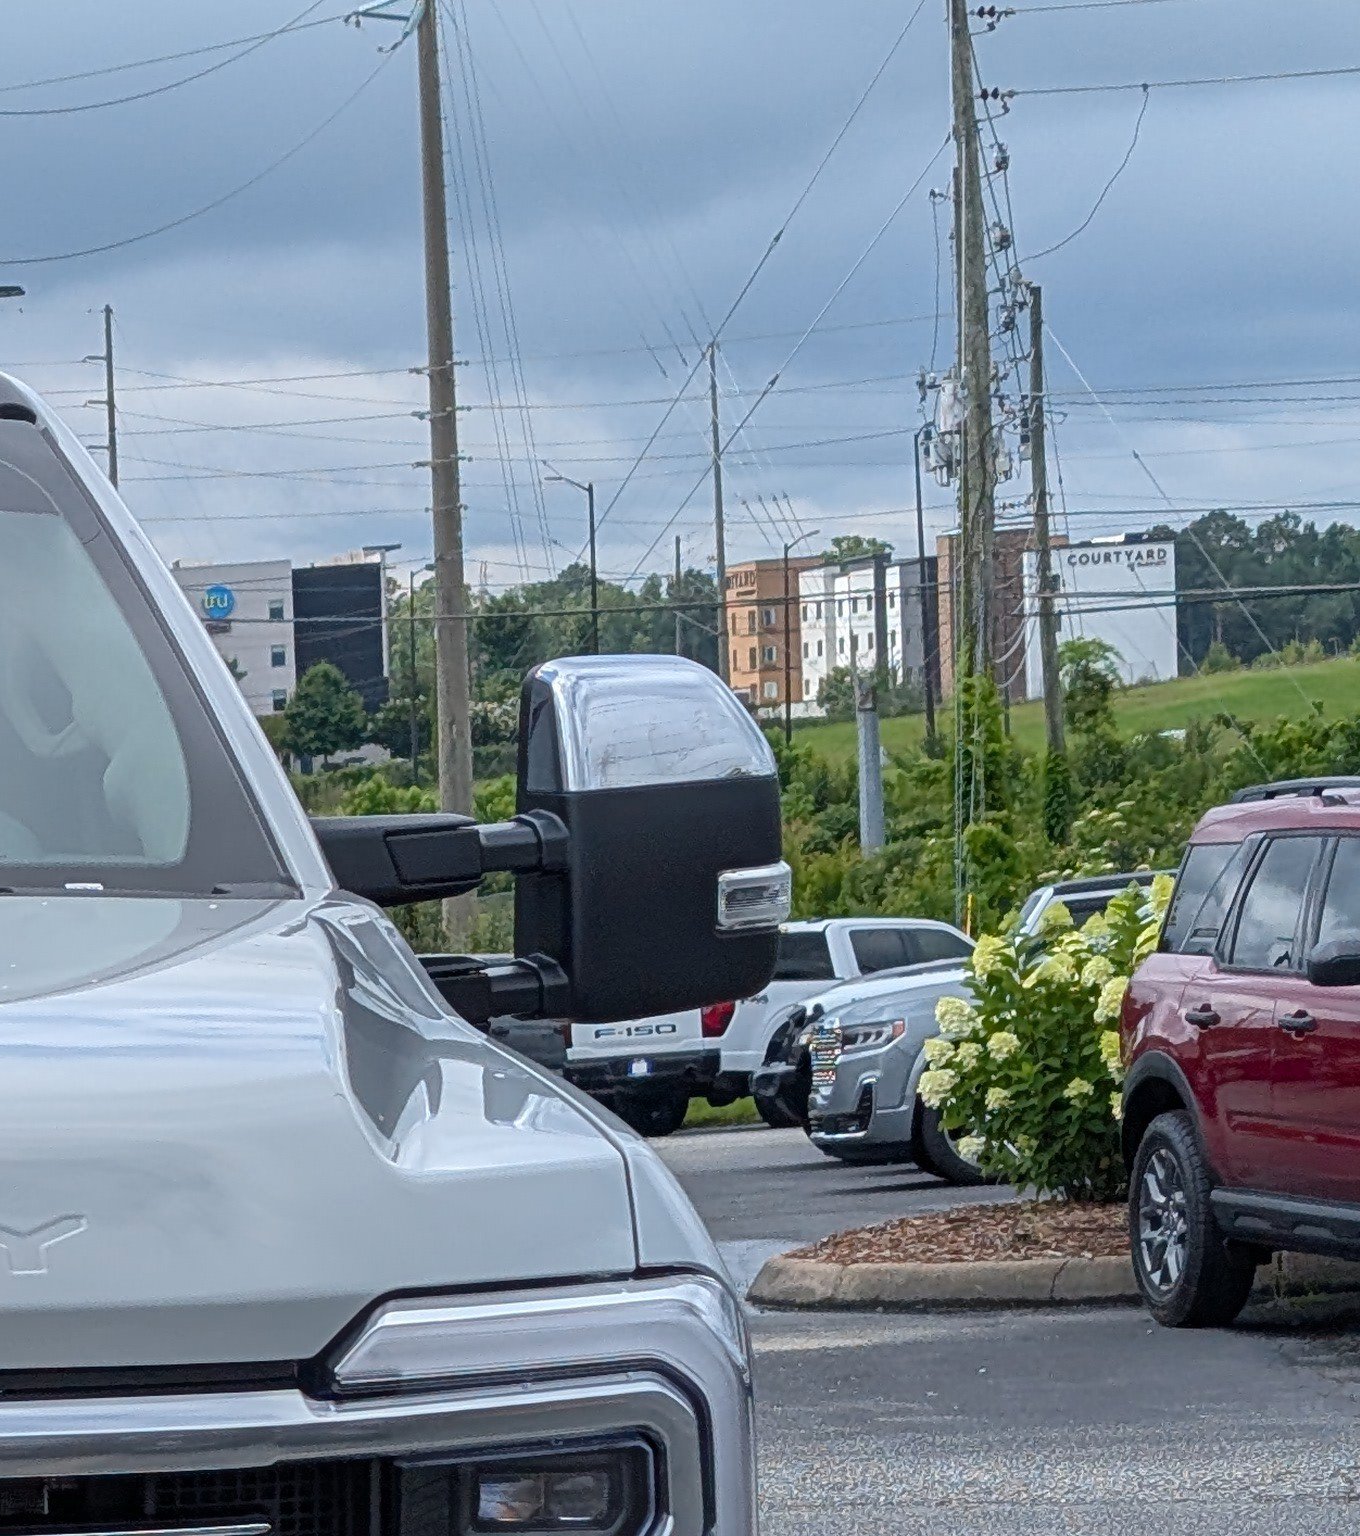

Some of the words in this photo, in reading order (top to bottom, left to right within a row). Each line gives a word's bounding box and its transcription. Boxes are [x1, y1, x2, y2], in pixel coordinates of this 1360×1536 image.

[1067, 547, 1168, 568] COURTYARD
[203, 592, 229, 609] tru
[594, 1023, 677, 1039] F-150
